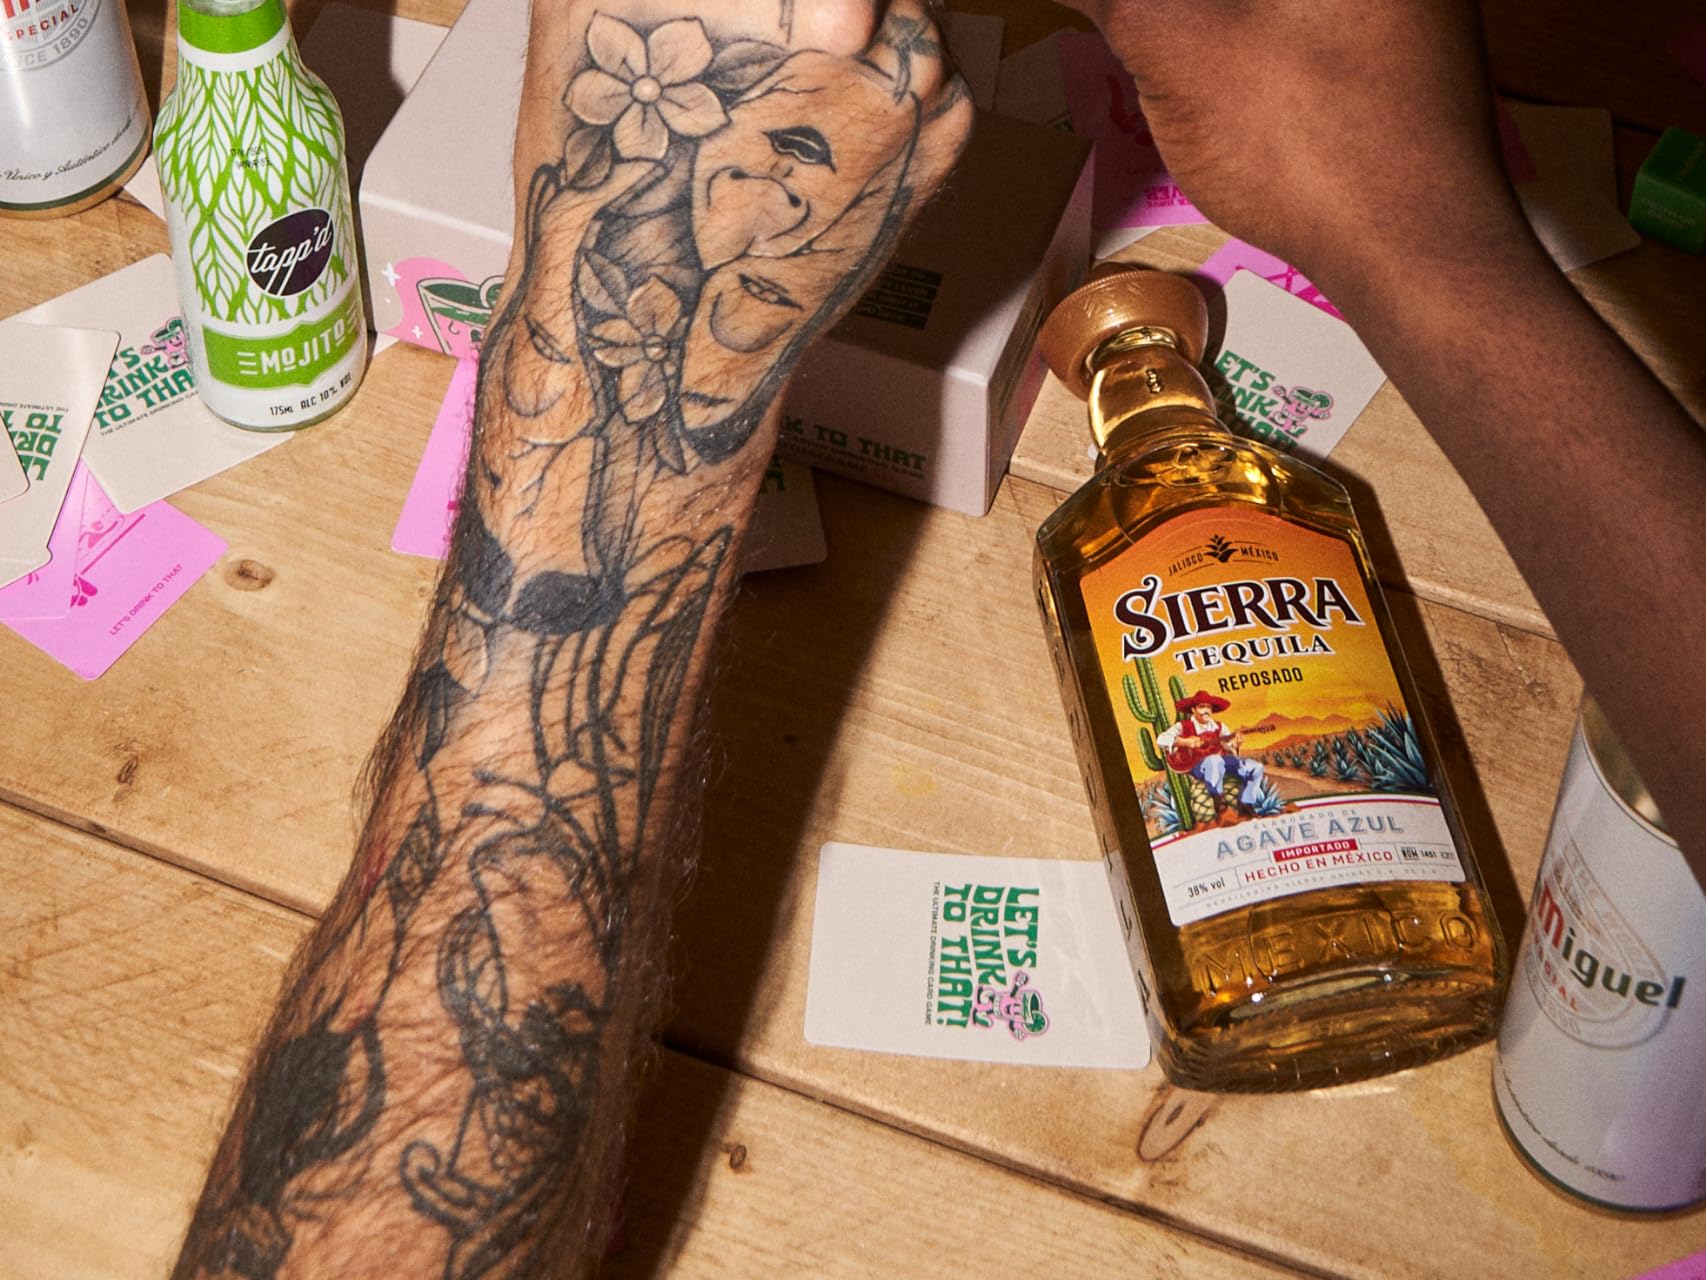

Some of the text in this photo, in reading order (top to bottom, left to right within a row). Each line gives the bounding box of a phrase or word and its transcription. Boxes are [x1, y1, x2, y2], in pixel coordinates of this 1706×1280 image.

[54, 17, 88, 54] 1890
[248, 214, 332, 296] tapp'd
[97, 354, 170, 409] RINK
[1214, 350, 1277, 392] ET'S
[95, 368, 196, 429] TO THA
[300, 396, 317, 410] ALC
[319, 385, 338, 402] 10%
[339, 372, 352, 389] VOL
[26, 412, 64, 434] TO
[814, 424, 848, 447] TO
[857, 437, 926, 472] THAT
[1168, 545, 1280, 577] JALISCO MÉXICO
[152, 582, 164, 593] TO
[1113, 574, 1366, 660] SIERRA
[1175, 633, 1334, 673] TEQUILA
[1217, 667, 1303, 693] REPOSADO
[1216, 815, 1404, 861] AGAVE AZUL
[1280, 841, 1351, 859] IMPORTADO
[1244, 850, 1393, 883] HECHO EN MÉXICO
[1187, 876, 1226, 899] 38% vol
[931, 896, 940, 934] ULTIMATE
[1004, 887, 1040, 968] LET'S
[928, 935, 937, 975] DRINKING
[970, 885, 1007, 986] DRINK
[936, 883, 973, 1029] TO THAT!
[926, 976, 935, 1000] CARD
[925, 1002, 934, 1025] GAME
